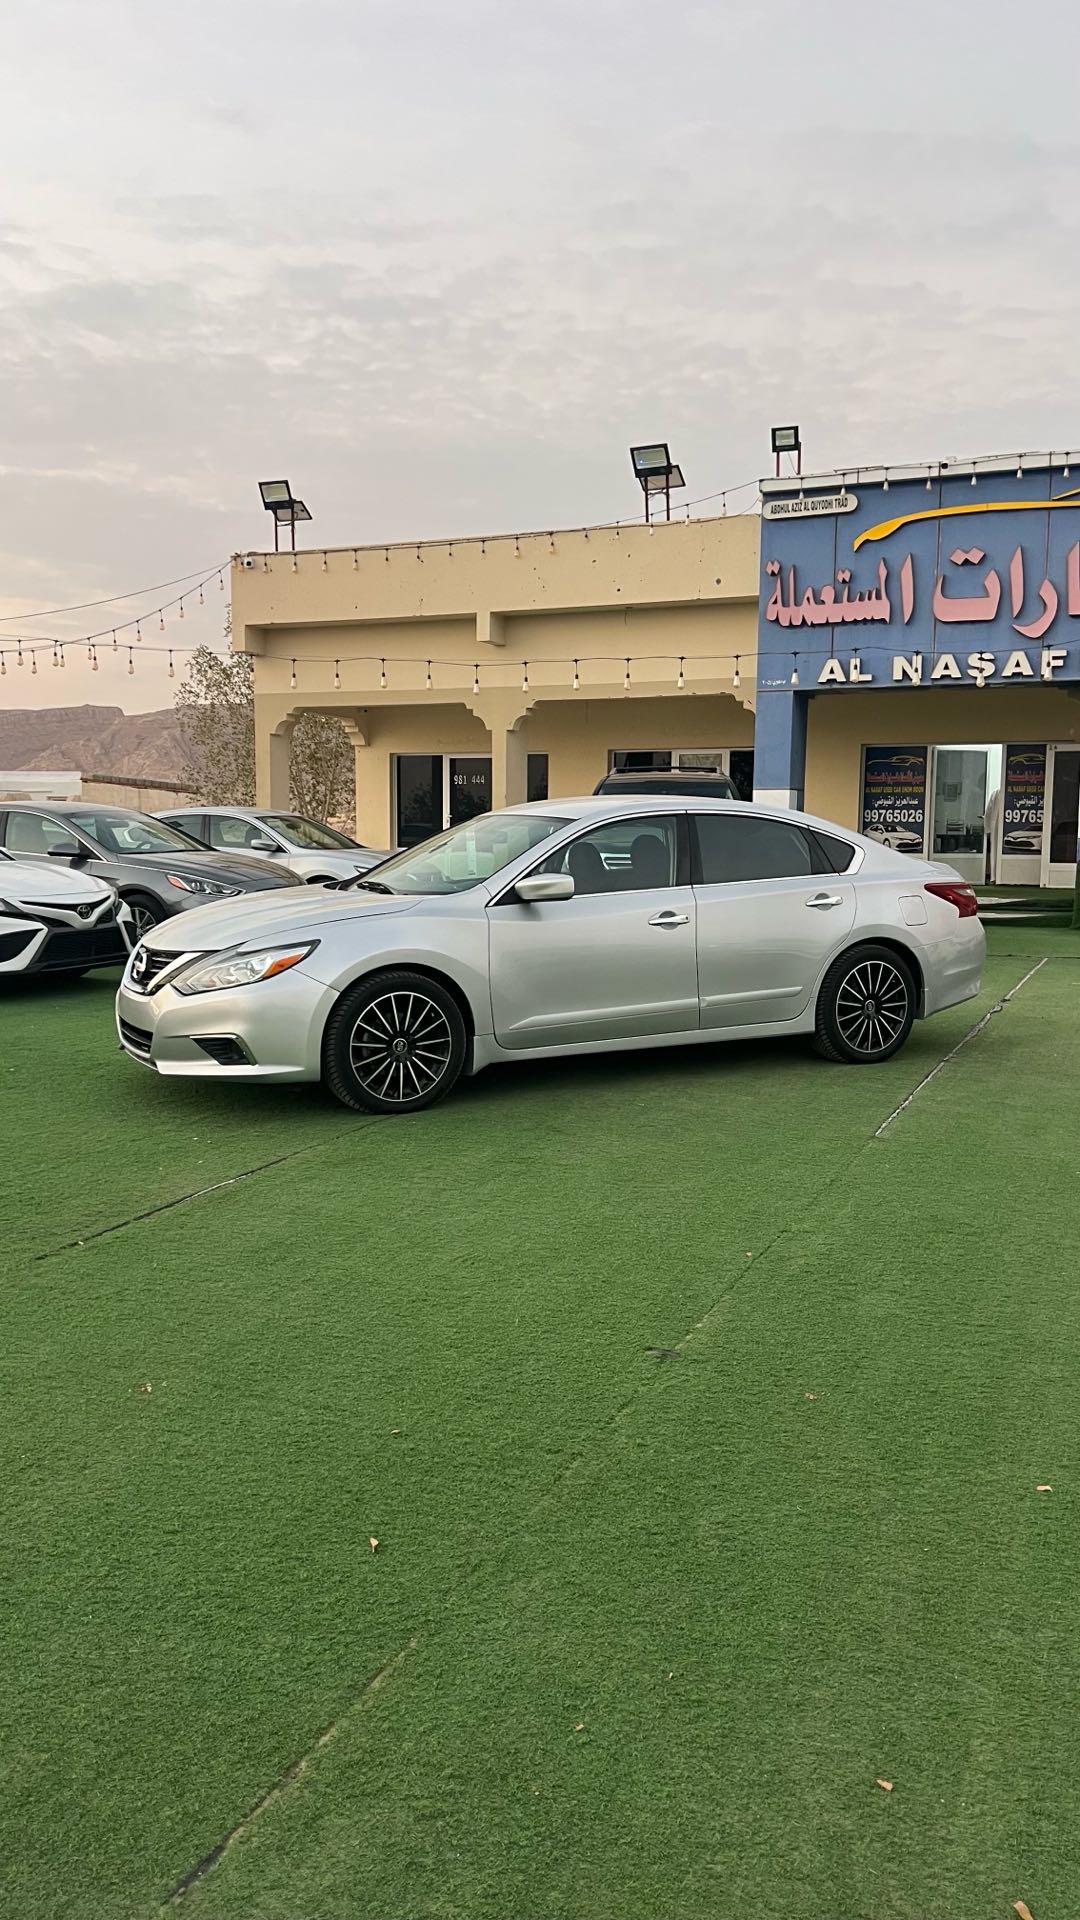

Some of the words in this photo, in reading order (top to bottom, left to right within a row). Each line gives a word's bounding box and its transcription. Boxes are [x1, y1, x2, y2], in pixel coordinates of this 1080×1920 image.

[791, 502, 802, 512] AZIZ
[803, 501, 810, 511] AL
[834, 497, 848, 508] TRAD
[765, 552, 914, 627] المستعملة
[817, 656, 873, 683] AL
[892, 649, 1068, 682] NASAF
[453, 775, 467, 784] 981
[864, 809, 924, 823] 99765026
[1005, 809, 1044, 823] 99765
